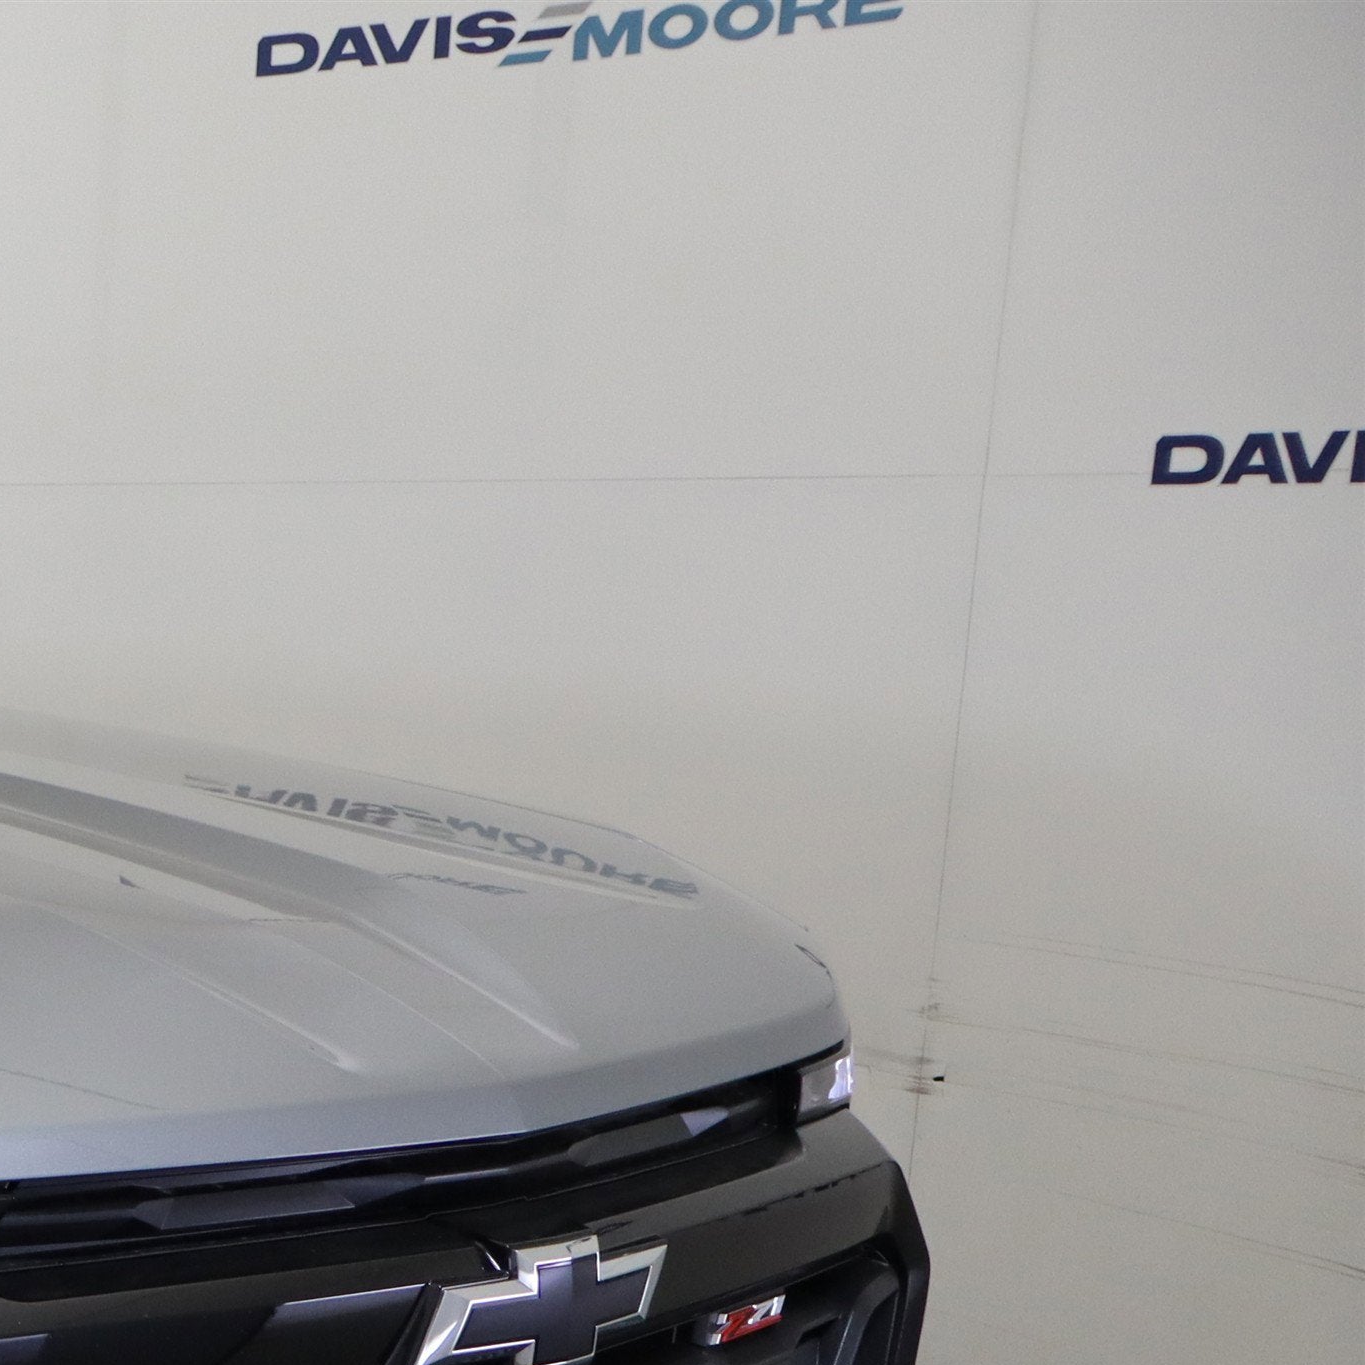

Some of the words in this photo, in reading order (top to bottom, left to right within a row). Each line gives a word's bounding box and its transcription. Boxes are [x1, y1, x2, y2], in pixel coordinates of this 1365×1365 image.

[255, 9, 517, 78] DAVIS
[571, 0, 904, 62] MOORE
[1151, 429, 1365, 486] DAVI
[709, 1294, 787, 1346] Z71
